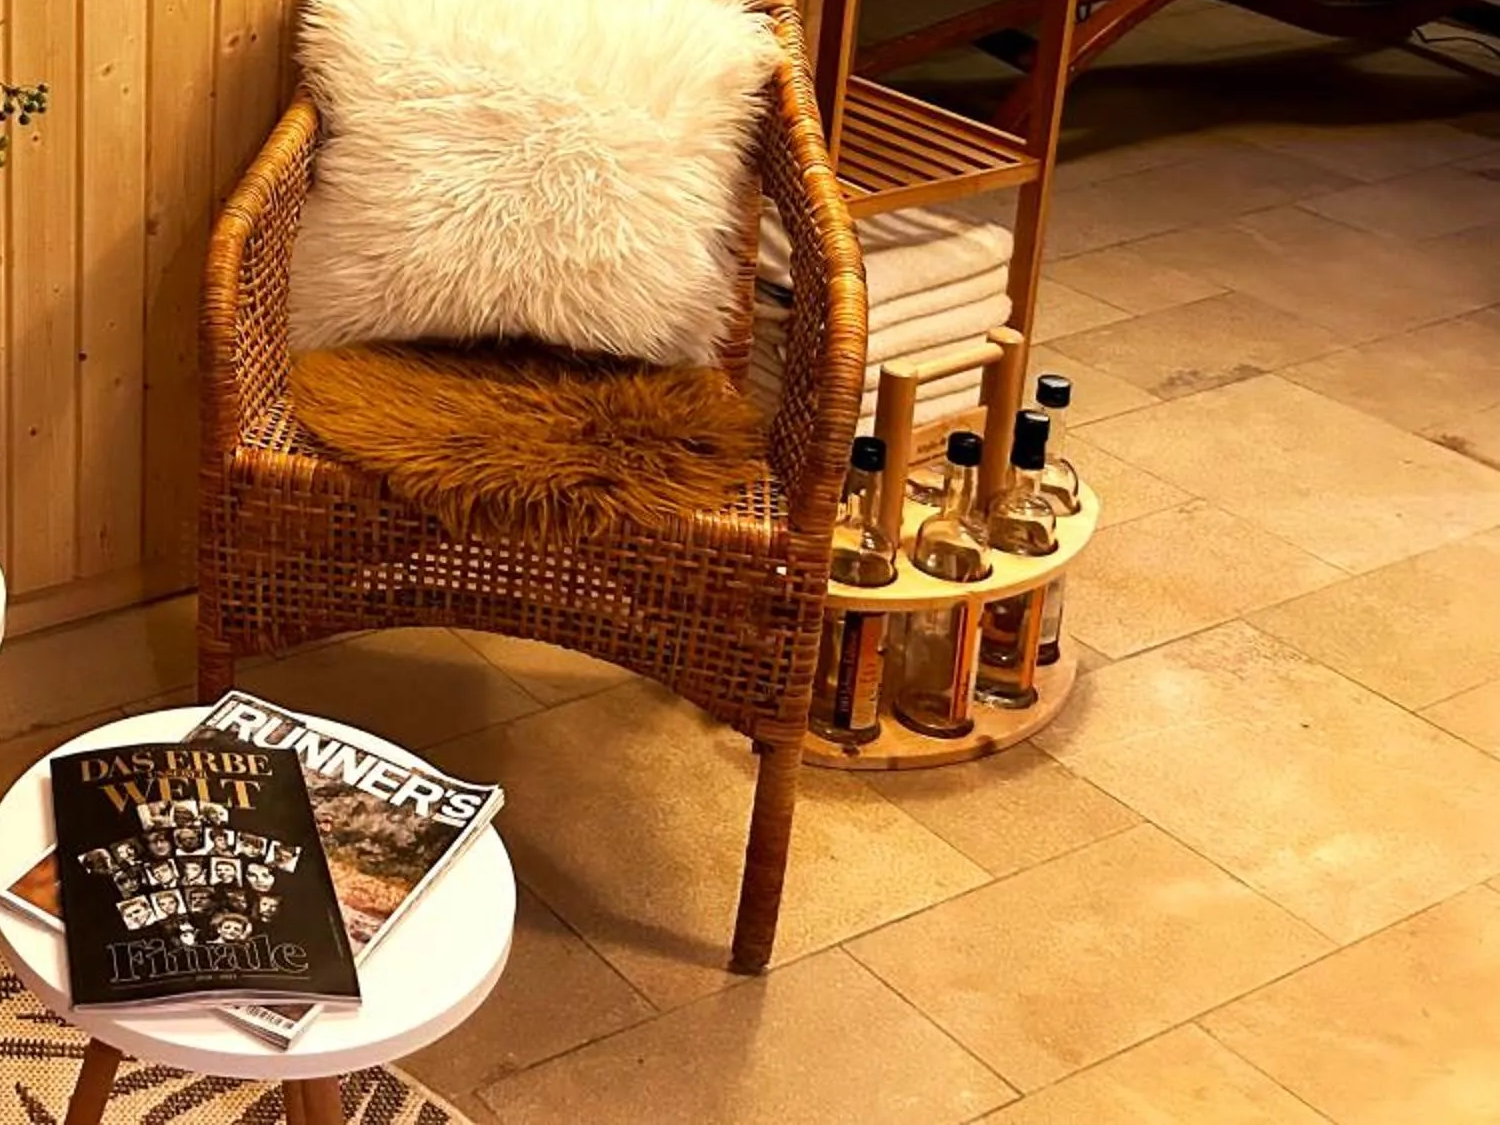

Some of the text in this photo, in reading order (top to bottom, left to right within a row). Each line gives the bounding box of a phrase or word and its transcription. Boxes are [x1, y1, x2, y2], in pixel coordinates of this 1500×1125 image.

[79, 750, 273, 782] DAS ERBE
[216, 703, 482, 819] RUNNER'S
[102, 777, 261, 812] WELT
[106, 933, 309, 982] Finale
